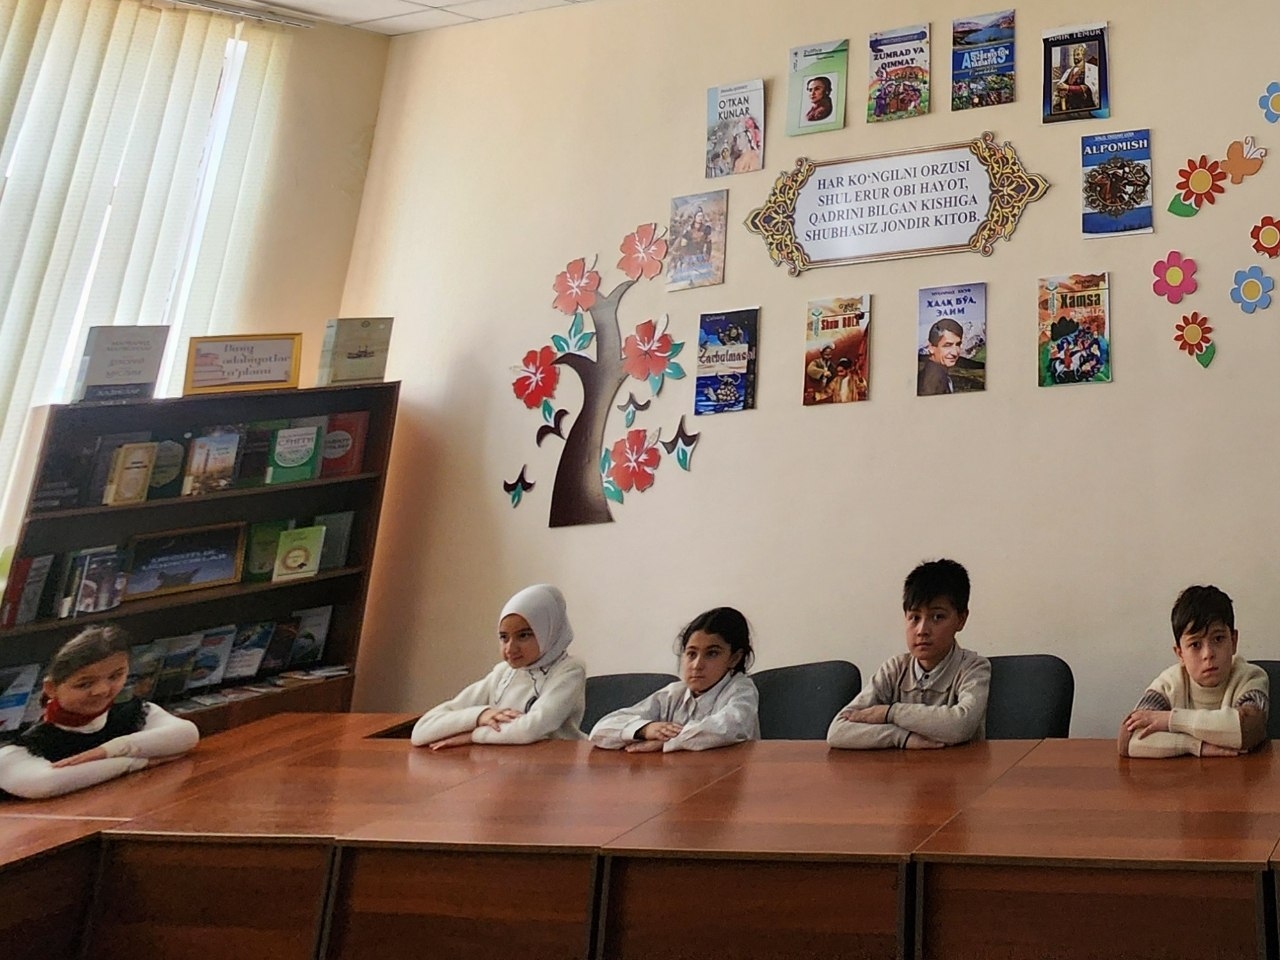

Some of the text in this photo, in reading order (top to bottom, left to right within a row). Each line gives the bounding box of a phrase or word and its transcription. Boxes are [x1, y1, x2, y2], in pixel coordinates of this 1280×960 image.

[873, 49, 911, 60] ZUMRAD
[881, 58, 916, 70] QIMMAT
[718, 107, 750, 120] KUNLAR
[1083, 139, 1148, 155] ALPOMISH
[818, 177, 844, 190] HAR
[920, 160, 970, 178] ORZUSI
[818, 177, 969, 207] SHUL ERUR OBI HAYOT,
[808, 194, 978, 226] QADRINI BILGAN KISHIGA
[805, 211, 981, 242] SHUBHASIZ JONDIR KITOB.
[1060, 293, 1101, 309] Xamsa
